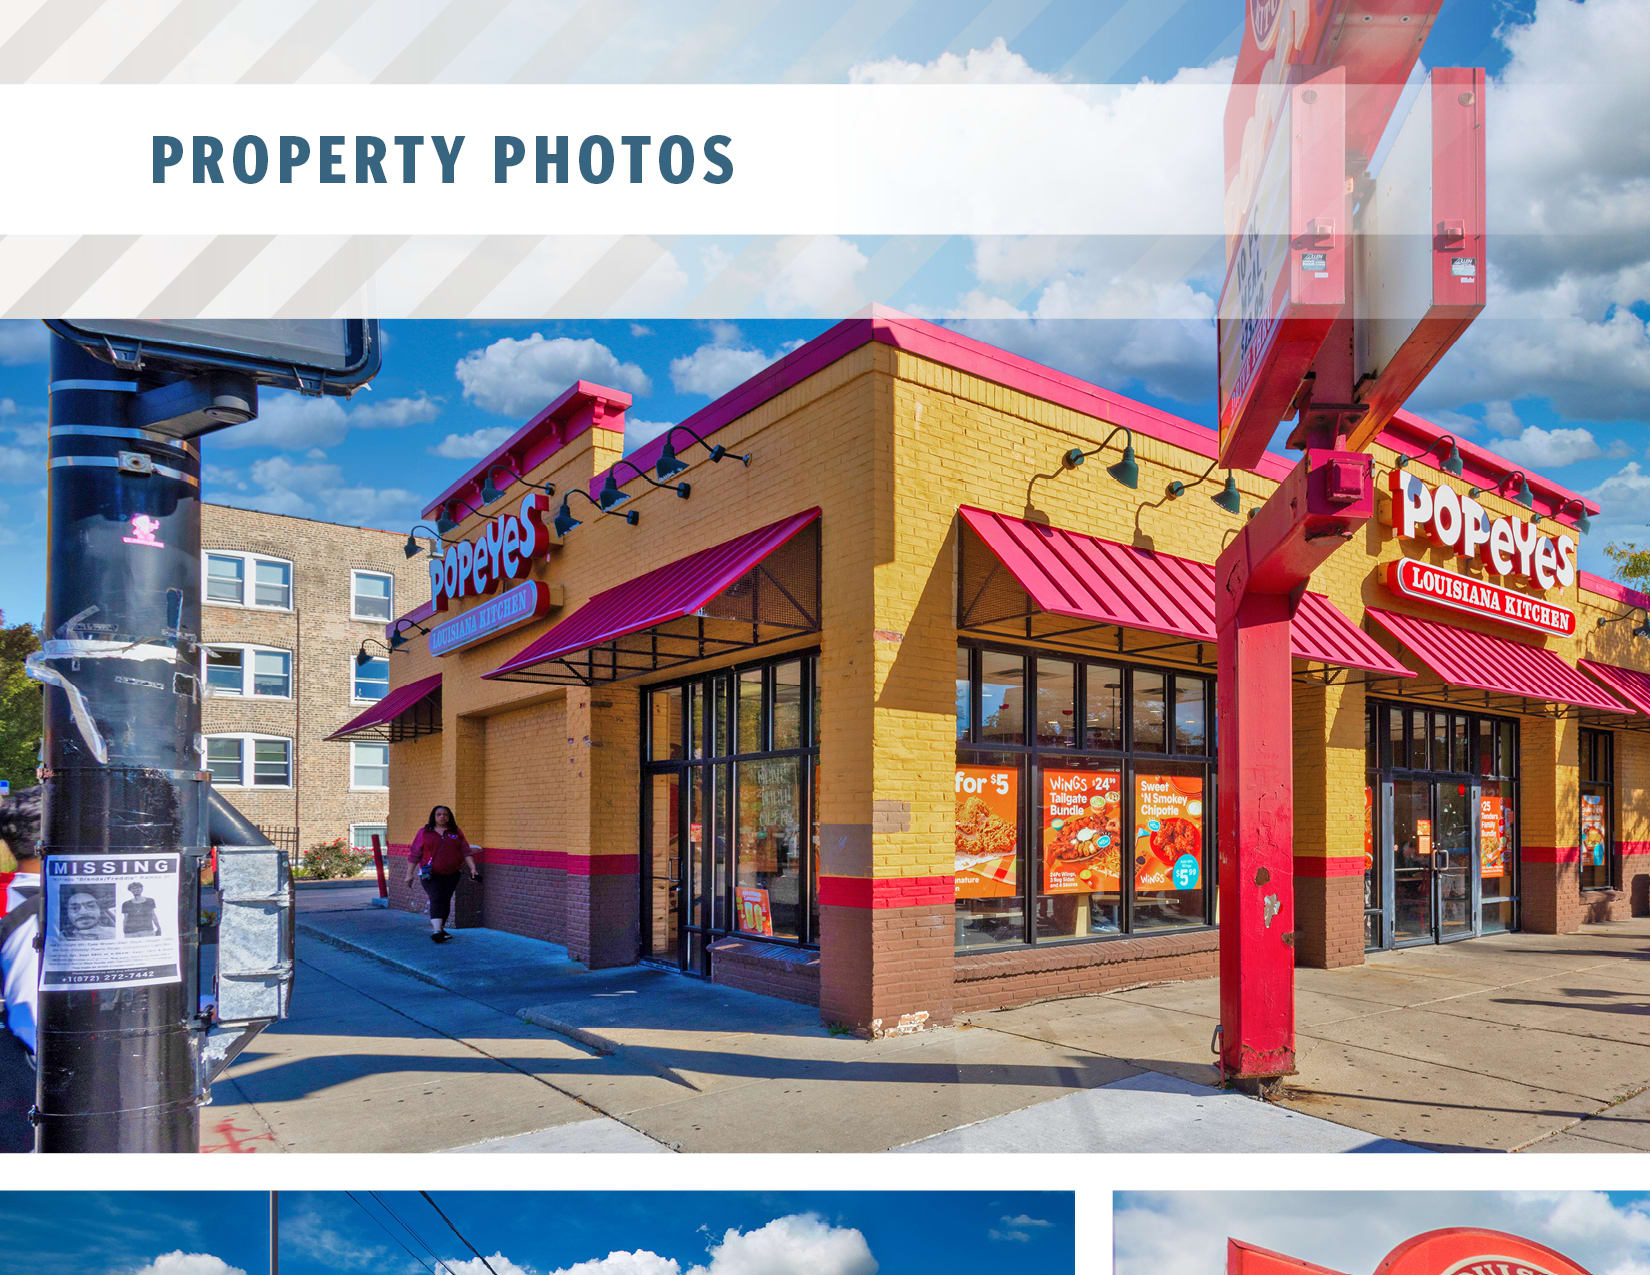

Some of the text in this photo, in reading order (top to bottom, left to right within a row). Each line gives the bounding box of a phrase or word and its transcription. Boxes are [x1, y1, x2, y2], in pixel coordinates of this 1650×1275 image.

[1412, 566, 1570, 631] LOUISIANA KITCHEN
[432, 589, 526, 648] LOUISIANA KITCHEN
[991, 774, 1009, 795] $5
[1141, 781, 1169, 791] Sweet
[1050, 793, 1087, 805] Tailgate
[1154, 793, 1187, 806] Smokey
[1050, 805, 1084, 815] Bundle
[1141, 805, 1179, 816] Chipotle
[54, 860, 168, 874] MISSING
[104, 971, 154, 980] 272-7442
